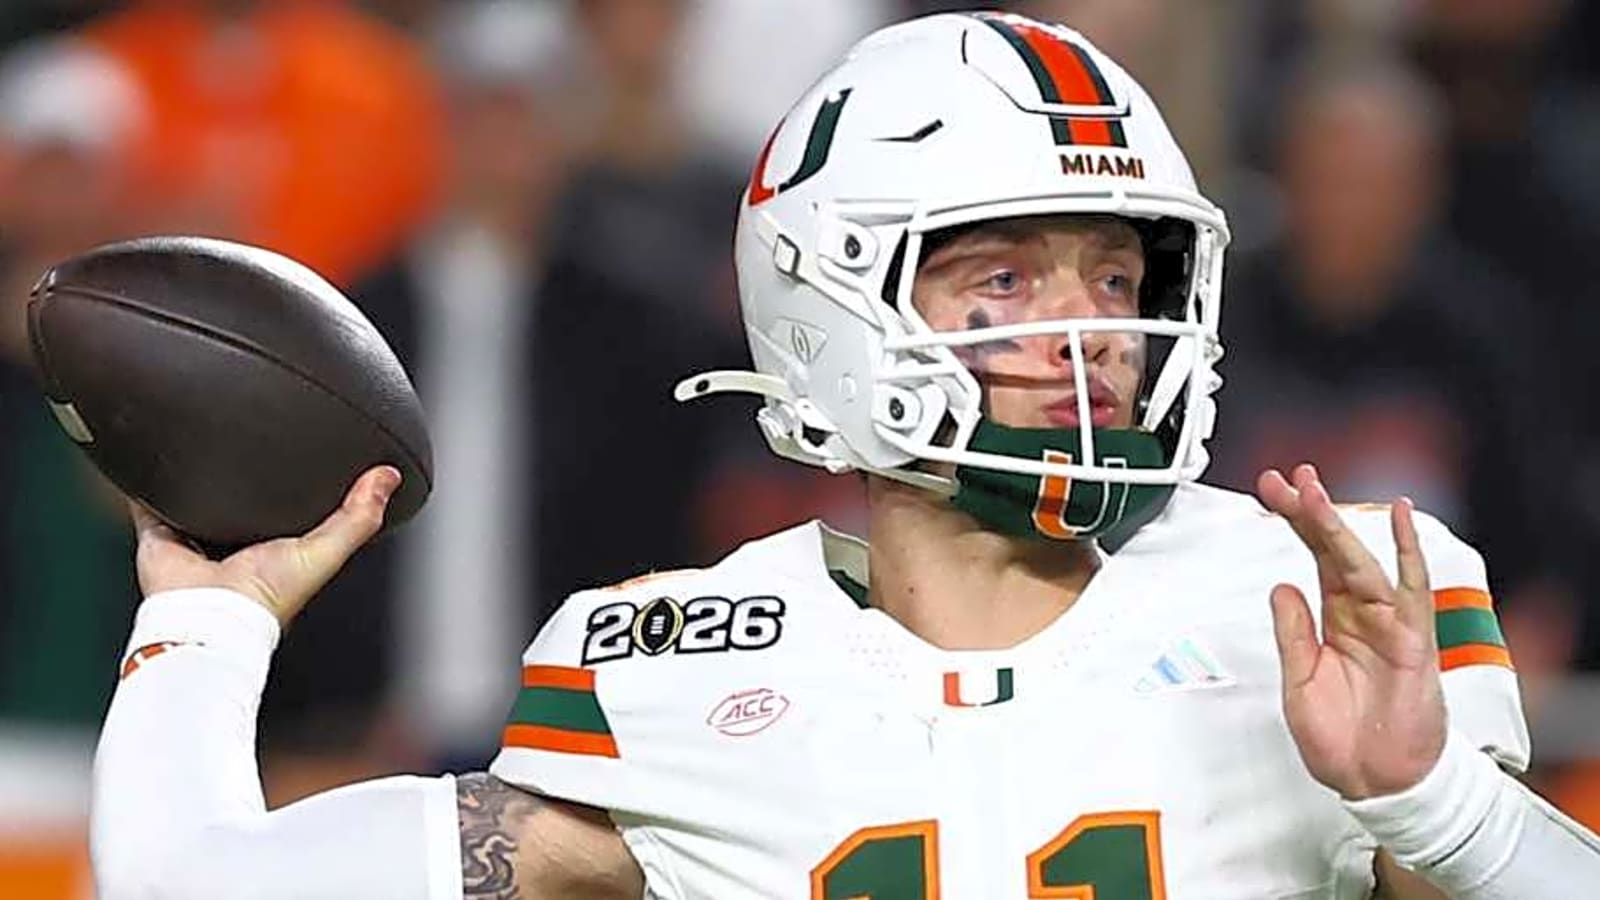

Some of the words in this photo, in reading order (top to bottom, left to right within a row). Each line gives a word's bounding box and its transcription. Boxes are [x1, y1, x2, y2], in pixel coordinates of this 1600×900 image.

[1059, 153, 1145, 179] MIAMI
[581, 596, 786, 666] 2026
[943, 667, 1014, 707] U
[721, 695, 775, 721] ACC
